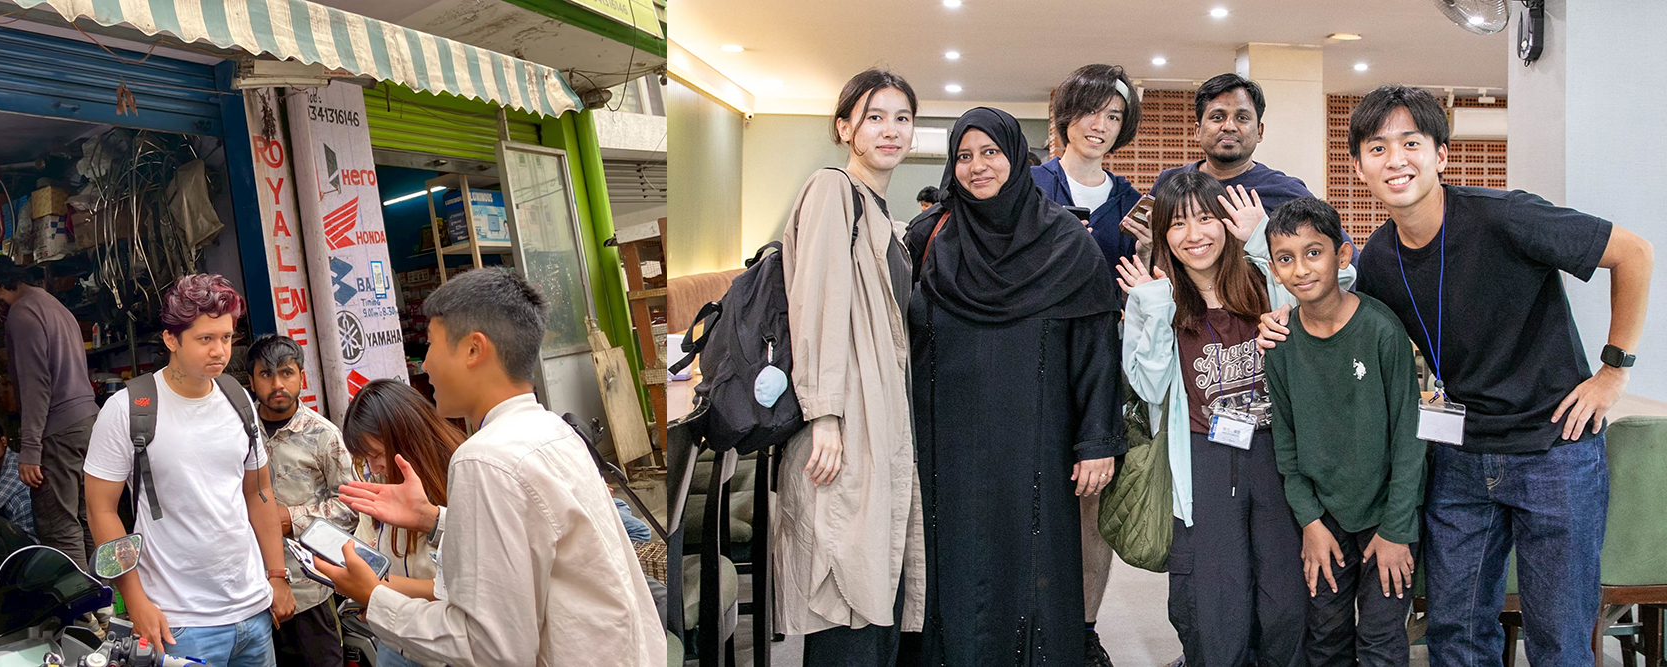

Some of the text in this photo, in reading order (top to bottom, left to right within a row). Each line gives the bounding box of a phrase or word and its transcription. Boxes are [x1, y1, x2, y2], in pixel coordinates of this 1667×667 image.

[355, 230, 387, 245] HONDA
[356, 275, 390, 292] BAJ
[366, 329, 402, 347] YAMAHA
